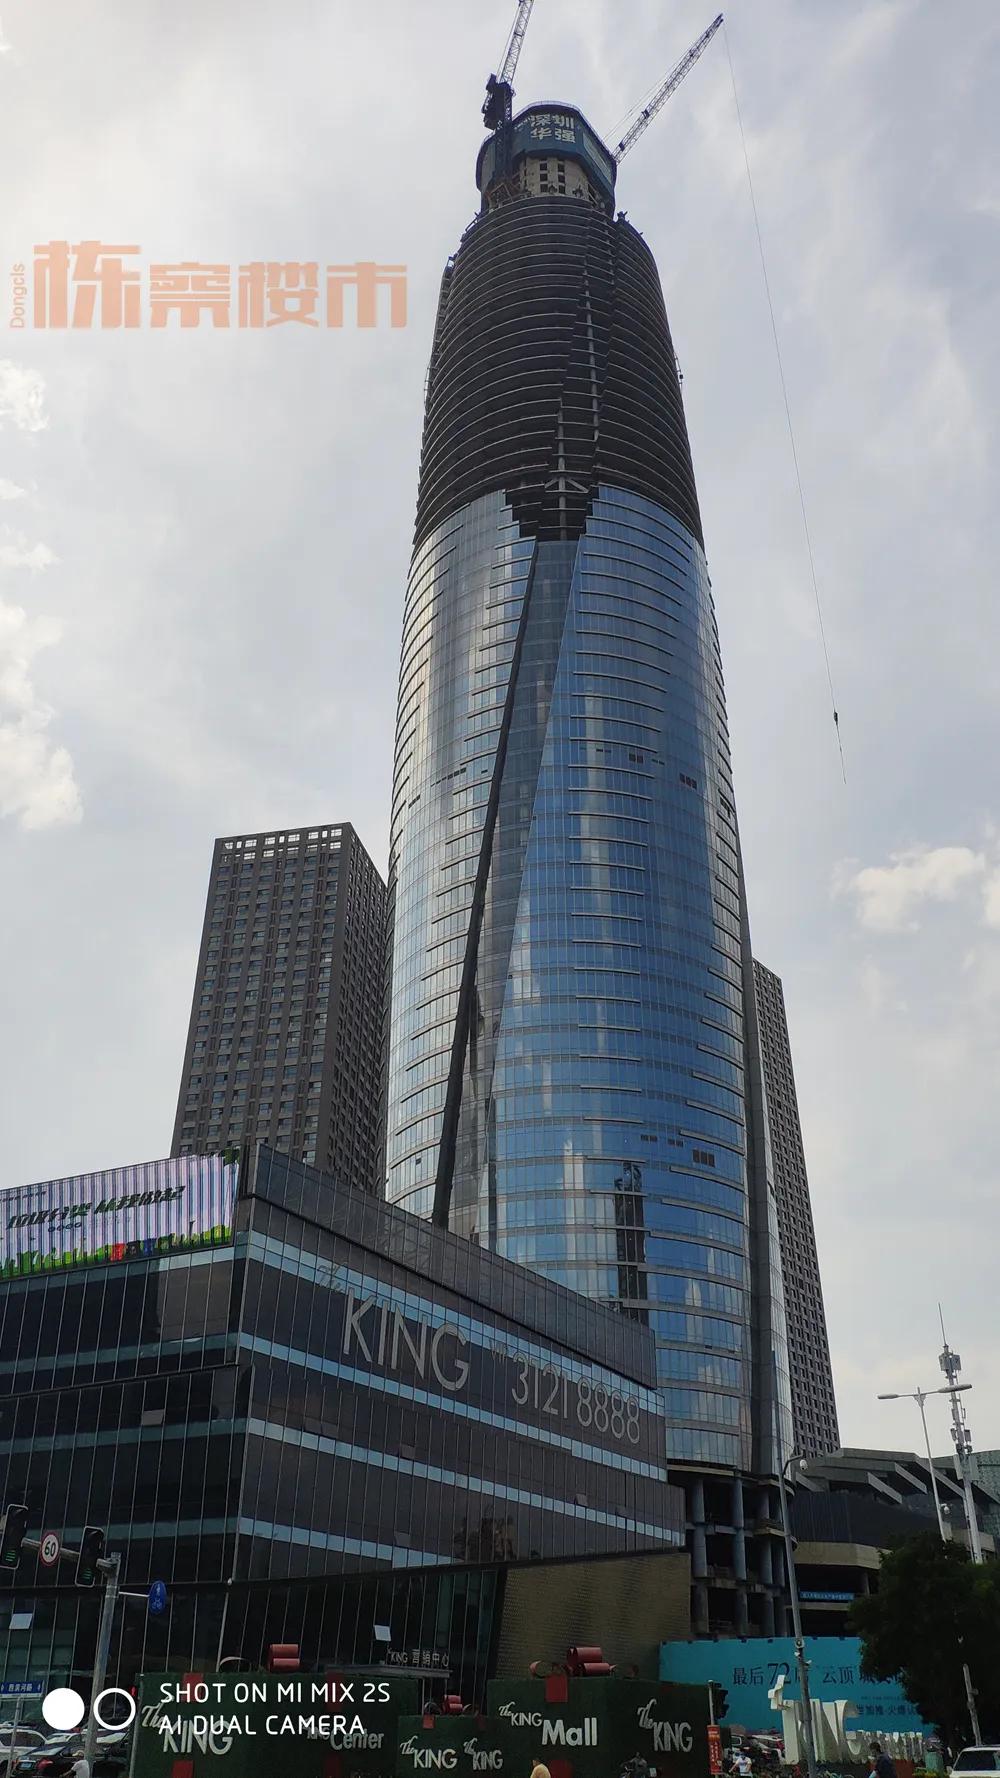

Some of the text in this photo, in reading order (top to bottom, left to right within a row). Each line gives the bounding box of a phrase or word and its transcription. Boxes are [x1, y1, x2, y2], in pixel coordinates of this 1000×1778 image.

[530, 114, 575, 129] 深圳
[530, 127, 576, 143] 华强
[343, 1286, 470, 1392] KING
[511, 1351, 569, 1420] 3121
[576, 1376, 641, 1445] 8888
[44, 1540, 57, 1557] 60
[163, 1719, 234, 1755] KING
[329, 1728, 385, 1751] Center
[511, 1712, 598, 1746] KING Mall
[652, 1722, 694, 1753] KING
[413, 1748, 458, 1770] KING
[472, 1749, 504, 1770] KING
